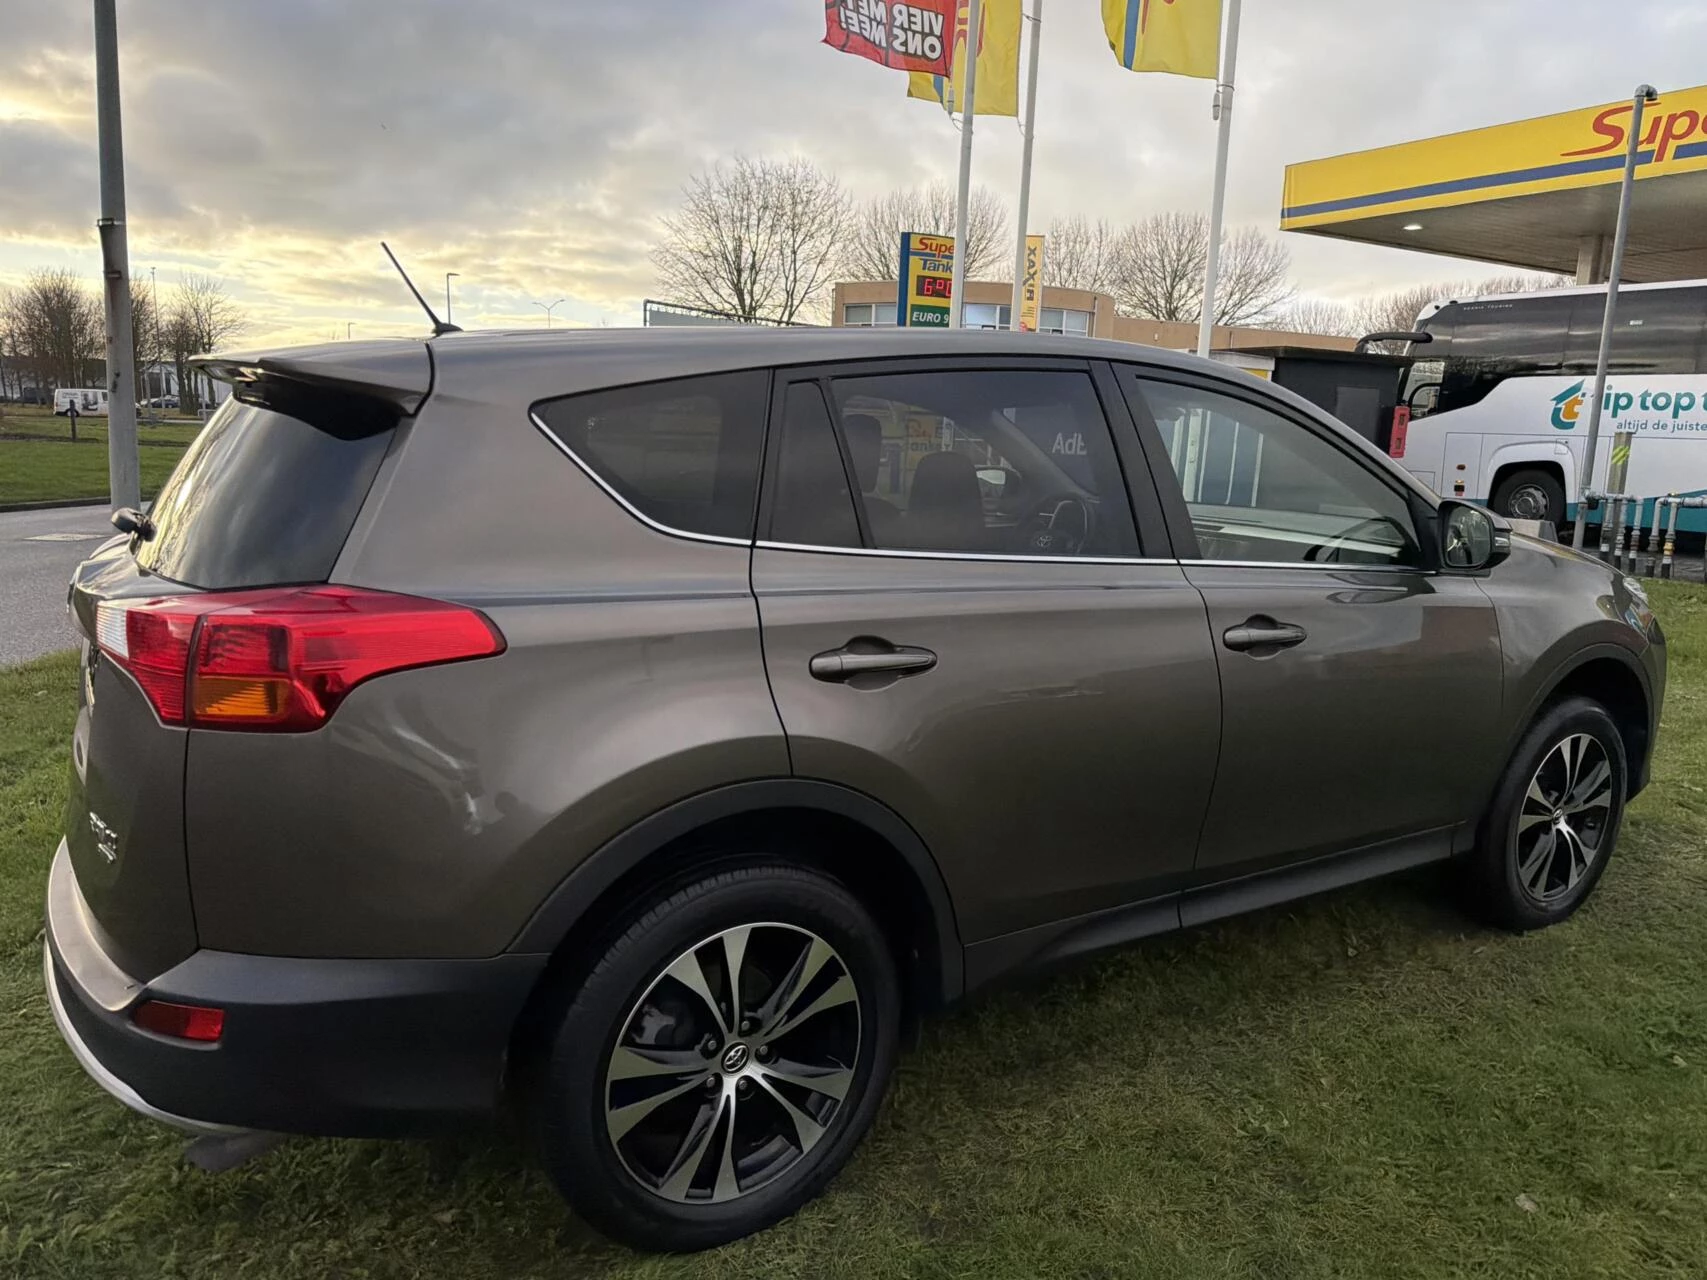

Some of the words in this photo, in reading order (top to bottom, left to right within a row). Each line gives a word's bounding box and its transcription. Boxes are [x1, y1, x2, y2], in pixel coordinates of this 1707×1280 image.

[911, 236, 955, 258] Supe
[912, 311, 941, 323] EURO
[1599, 384, 1634, 418] ip
[1638, 389, 1697, 419] top
[1616, 418, 1649, 433] altijd
[1651, 419, 1668, 431] de
